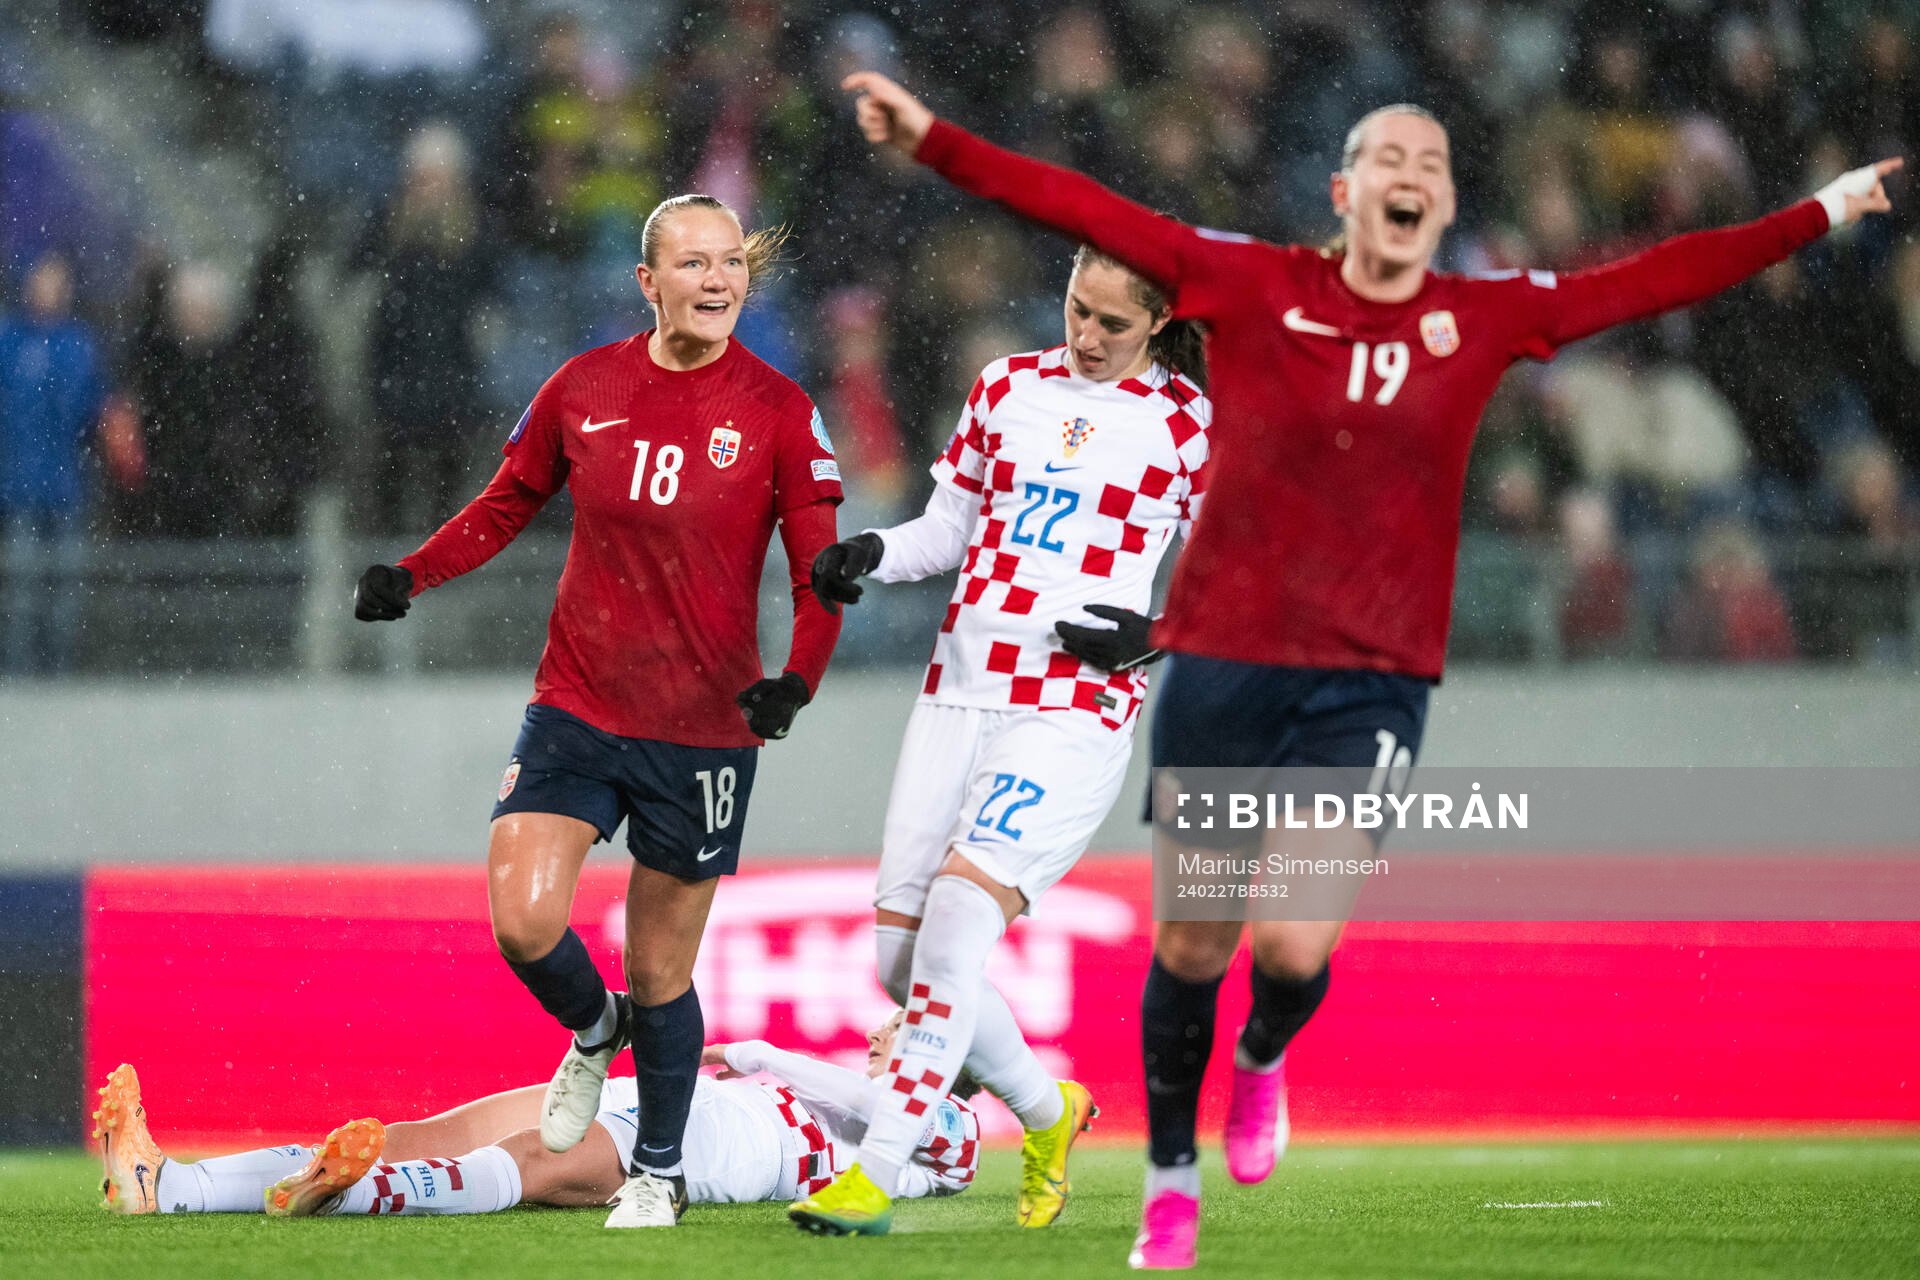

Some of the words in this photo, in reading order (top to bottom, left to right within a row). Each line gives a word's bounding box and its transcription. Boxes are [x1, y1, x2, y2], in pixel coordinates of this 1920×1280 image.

[1346, 341, 1410, 406] 19
[629, 439, 685, 506] 18
[1011, 482, 1080, 554] 22
[695, 766, 737, 834] 18
[975, 773, 1045, 841] 22
